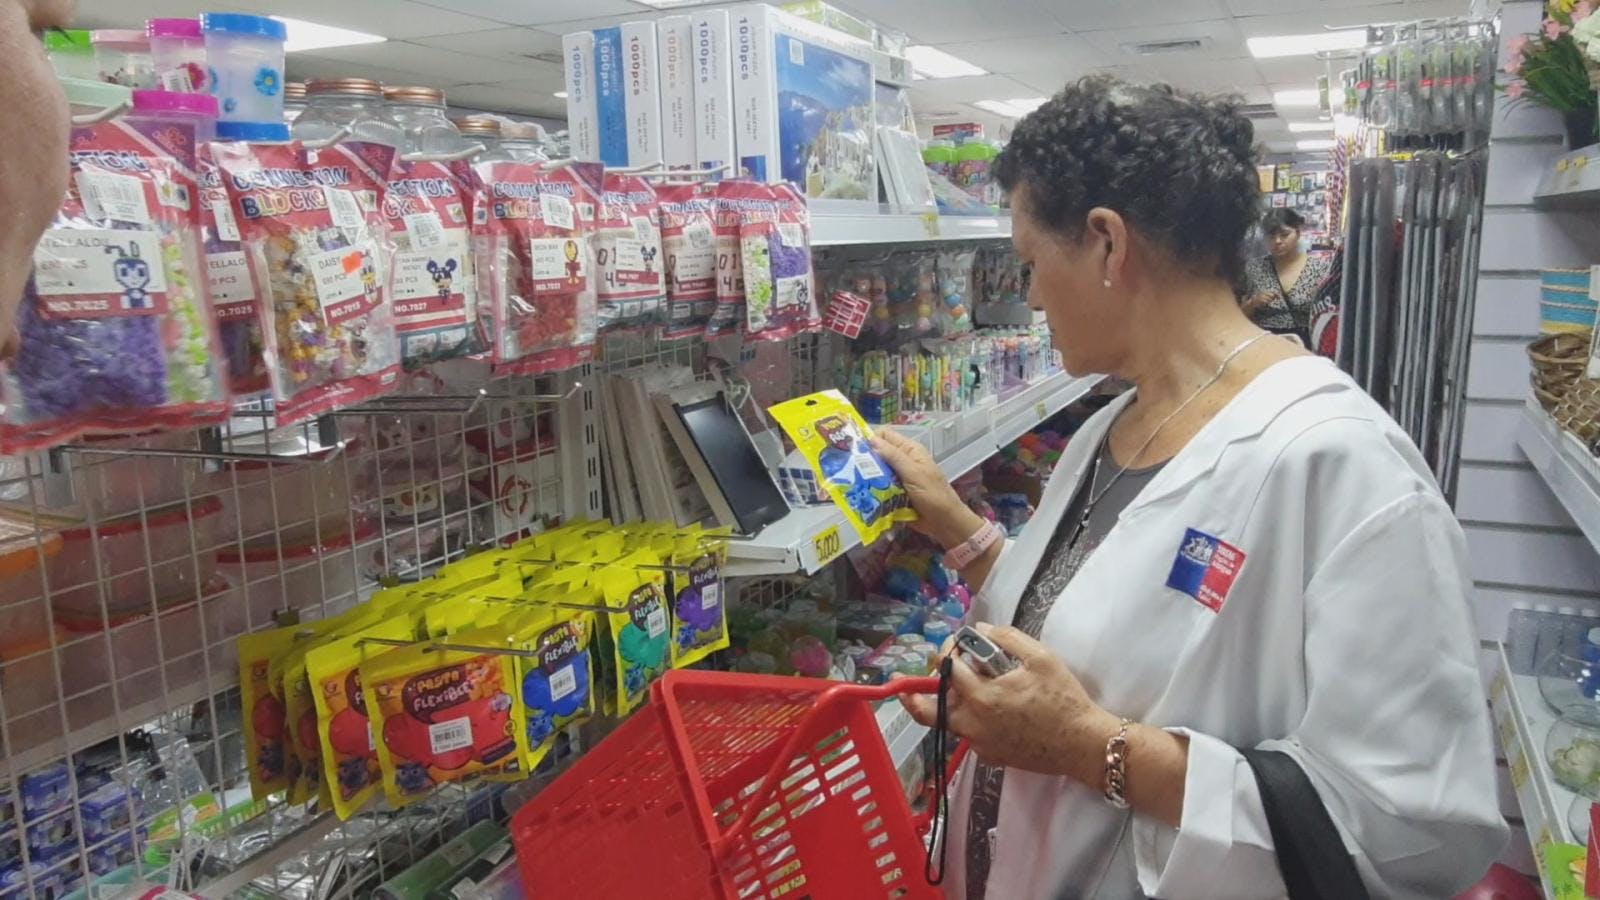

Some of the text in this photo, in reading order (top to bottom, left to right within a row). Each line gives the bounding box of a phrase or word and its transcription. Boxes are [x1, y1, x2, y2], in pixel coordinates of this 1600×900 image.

[600, 38, 611, 96] 1000pcs
[631, 35, 641, 96] 1000pcs
[699, 20, 709, 83] 1000pcs
[739, 17, 750, 80] 1000pcs
[417, 670, 460, 693] PASTA
